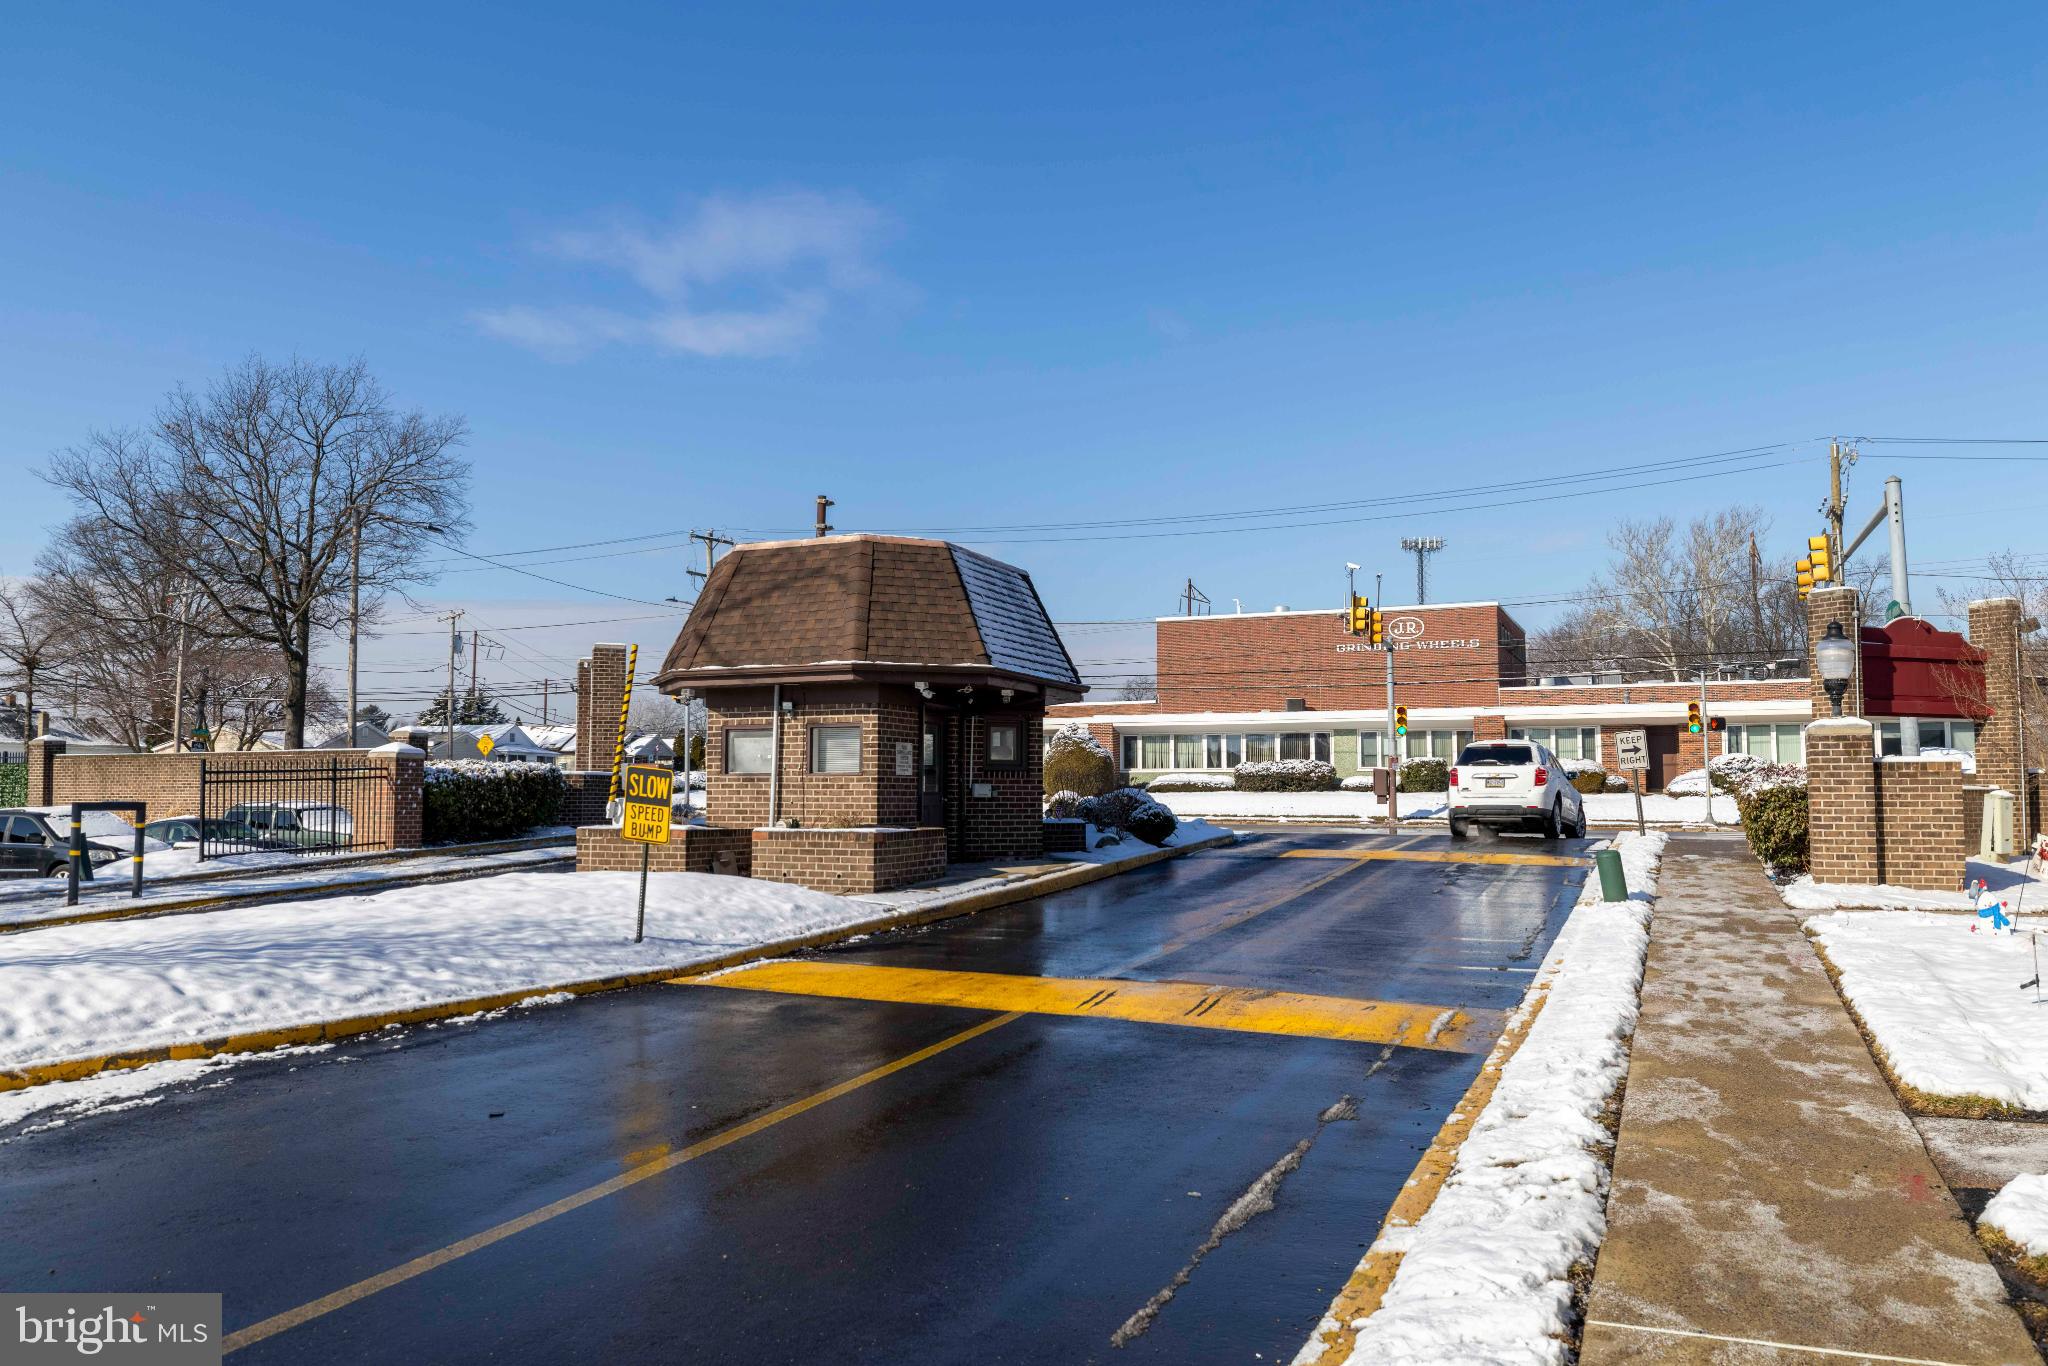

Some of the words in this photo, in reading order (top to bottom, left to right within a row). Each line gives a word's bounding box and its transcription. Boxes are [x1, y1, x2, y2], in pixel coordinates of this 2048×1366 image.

[1336, 641, 1410, 653] GRINDNG
[1416, 638, 1480, 650] WHEELS
[1620, 736, 1642, 745] KEEP
[1620, 755, 1646, 765] RIGHT
[629, 773, 670, 800] SLOW
[630, 804, 664, 823] SPEED
[631, 821, 662, 839] BUMP
